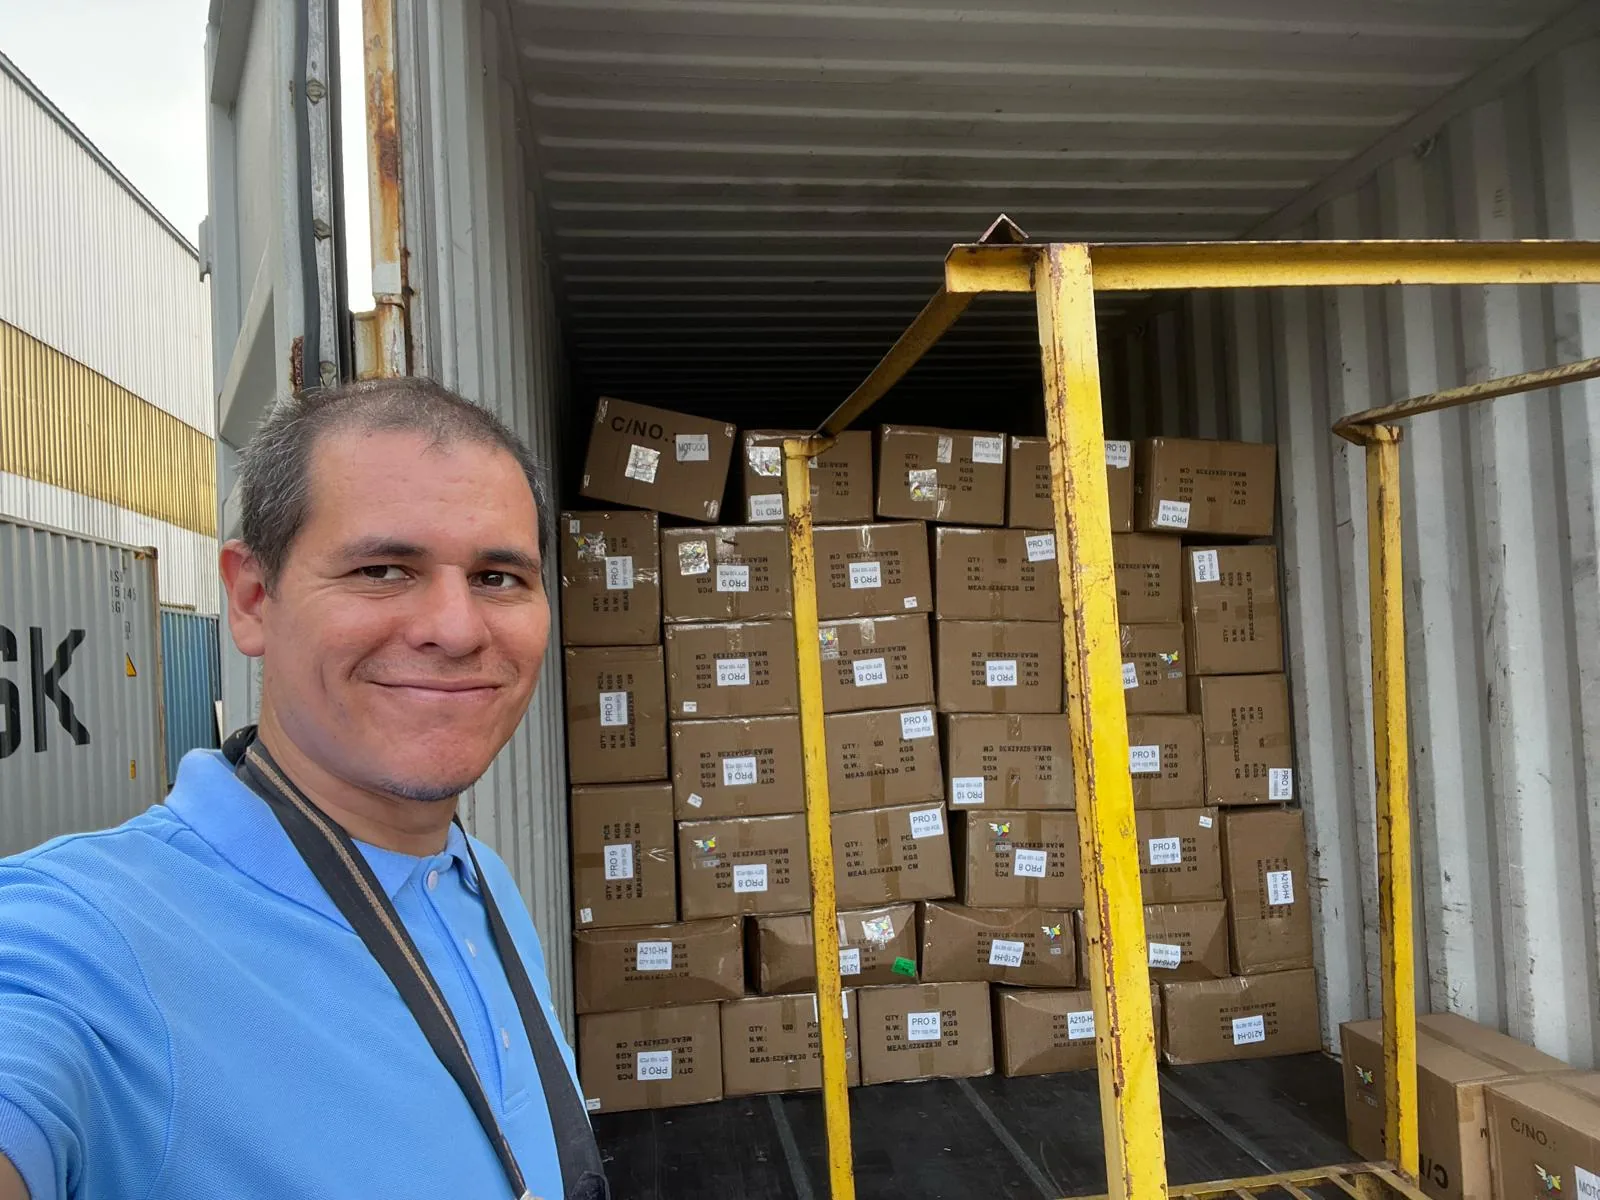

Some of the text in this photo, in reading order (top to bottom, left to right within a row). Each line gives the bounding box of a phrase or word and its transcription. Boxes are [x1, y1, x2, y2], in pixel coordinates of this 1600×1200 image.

[975, 441, 989, 449] PRO
[1172, 515, 1186, 523] PRO
[1028, 540, 1043, 548] PRO
[866, 672, 882, 680] PRO
[904, 717, 921, 725] PRO
[913, 815, 930, 824] PRO
[1153, 843, 1169, 851] PRO
[610, 858, 618, 876] PRO
[1025, 864, 1042, 872] PRO
